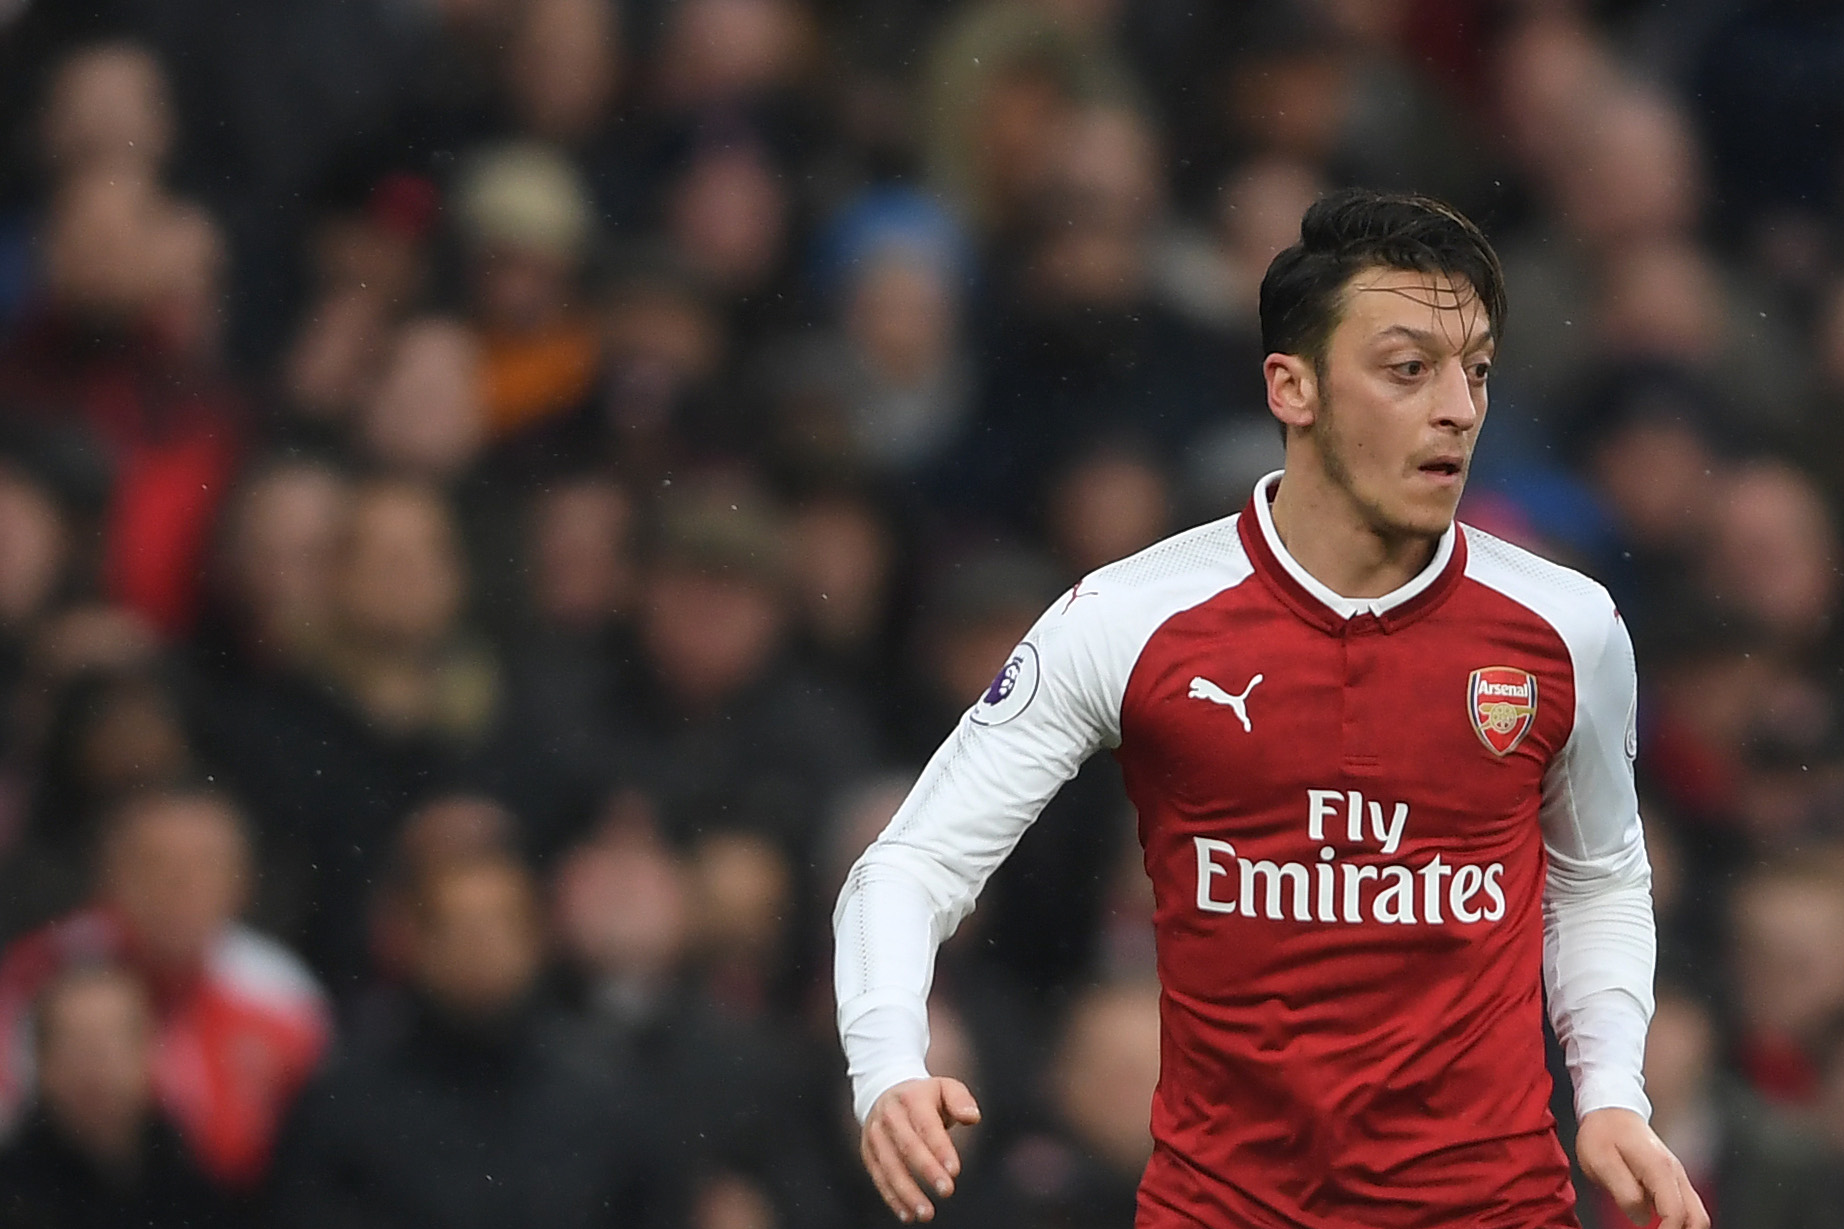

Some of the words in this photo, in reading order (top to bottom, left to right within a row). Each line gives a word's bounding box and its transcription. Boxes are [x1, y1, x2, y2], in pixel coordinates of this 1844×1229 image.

[1477, 679, 1529, 698] Arsenal
[1307, 789, 1408, 853] Fly
[1193, 836, 1504, 925] Emirates
